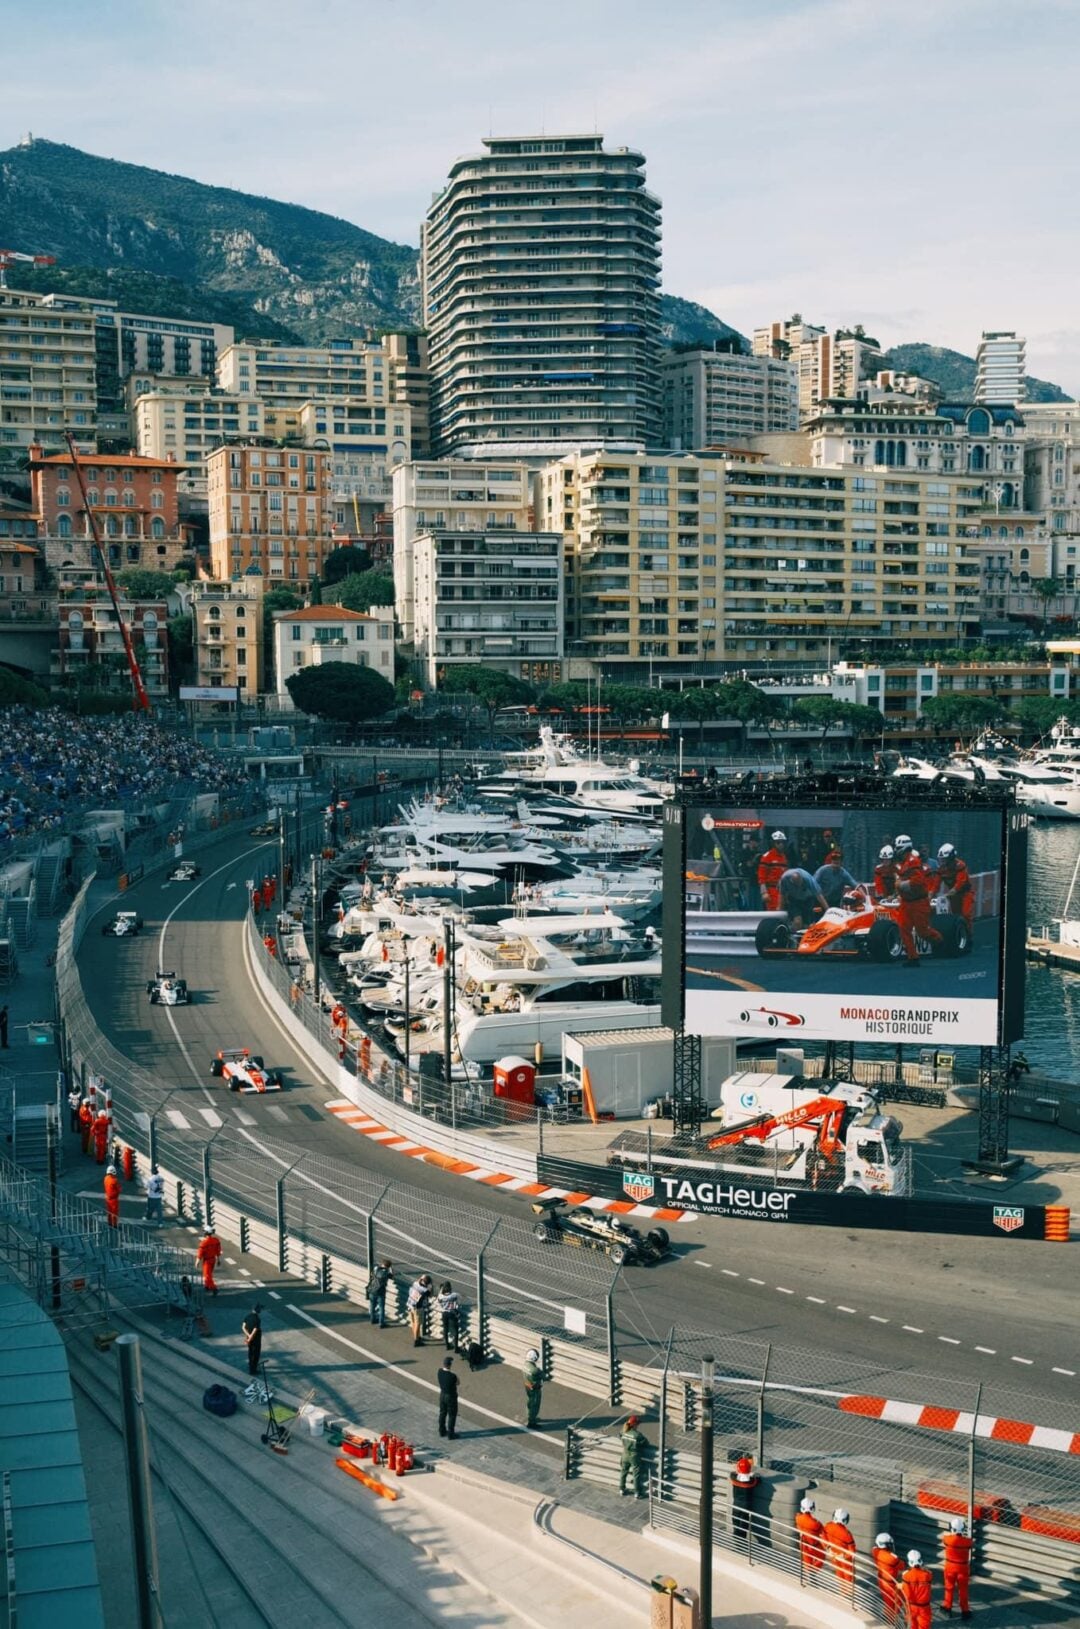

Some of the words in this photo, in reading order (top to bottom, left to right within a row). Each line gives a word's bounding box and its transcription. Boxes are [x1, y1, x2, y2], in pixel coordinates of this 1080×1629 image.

[840, 1008, 890, 1020] MONACO
[865, 1021, 933, 1035] HISTORIQUE
[625, 1174, 652, 1187] TAG
[624, 1184, 652, 1200] HEUER
[667, 1200, 701, 1211] OFFICIAL
[702, 1205, 730, 1214] WATCH
[732, 1208, 769, 1218] MONACO
[996, 1208, 1022, 1217] TAG
[995, 1217, 1022, 1230] HEUER
